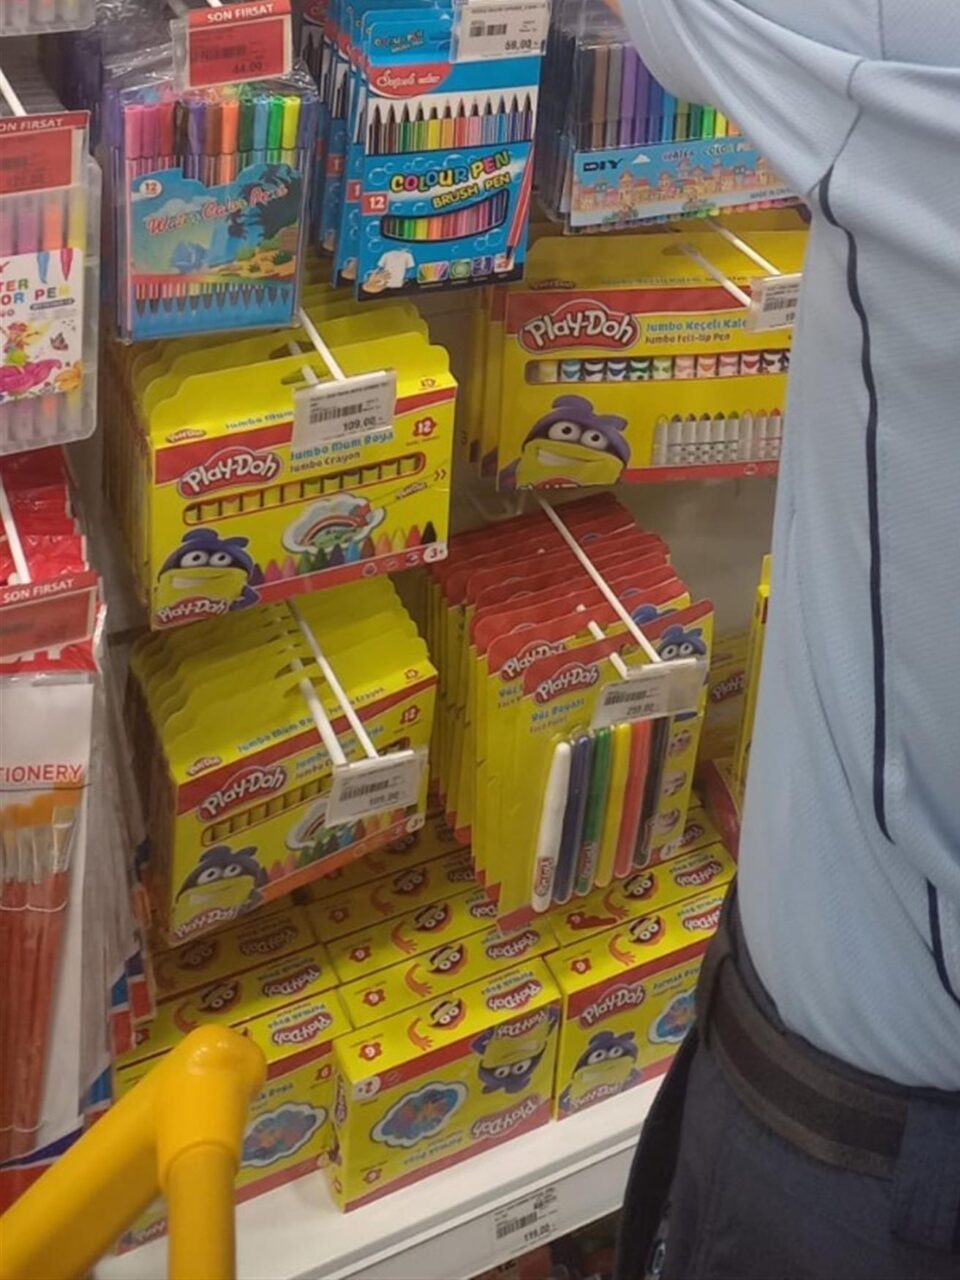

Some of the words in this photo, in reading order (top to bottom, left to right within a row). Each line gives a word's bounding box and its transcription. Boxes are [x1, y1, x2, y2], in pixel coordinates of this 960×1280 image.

[207, 10, 233, 23] SON
[235, 3, 274, 19] FIRSAT
[20, 118, 64, 131] FIRSAT
[472, 150, 510, 180] PEN
[144, 182, 157, 192] 12
[390, 165, 470, 193] COLOUR
[484, 172, 512, 192] PEN
[369, 196, 384, 209] 12
[432, 184, 479, 209] BRUSH
[523, 309, 635, 347] Play-Doh
[645, 333, 674, 343] Jumbo
[713, 332, 731, 342] Pen
[646, 320, 683, 332] Jumbo
[685, 319, 722, 332] Keçeli
[417, 420, 432, 435] 12
[291, 444, 329, 461] Jumbo
[331, 440, 362, 453] Mum
[364, 431, 394, 448] Boya
[324, 452, 361, 466] Crayon
[181, 452, 277, 494] Play-Doh
[430, 547, 445, 558] 3+
[4, 590, 30, 604] SON
[33, 579, 74, 597] FIRSAT
[157, 599, 228, 622] Play-Doh
[540, 667, 598, 700] Play-Doh
[4, 764, 82, 783] IONERY
[202, 770, 285, 817] Play-Doh
[486, 931, 537, 959] Play-Doh
[262, 966, 320, 996] Play-Doh
[487, 980, 541, 1010] Play-Doh
[583, 988, 643, 1025] Play-Doh
[273, 1013, 331, 1046] Play-Doh
[473, 1098, 536, 1138] Play-Doh
